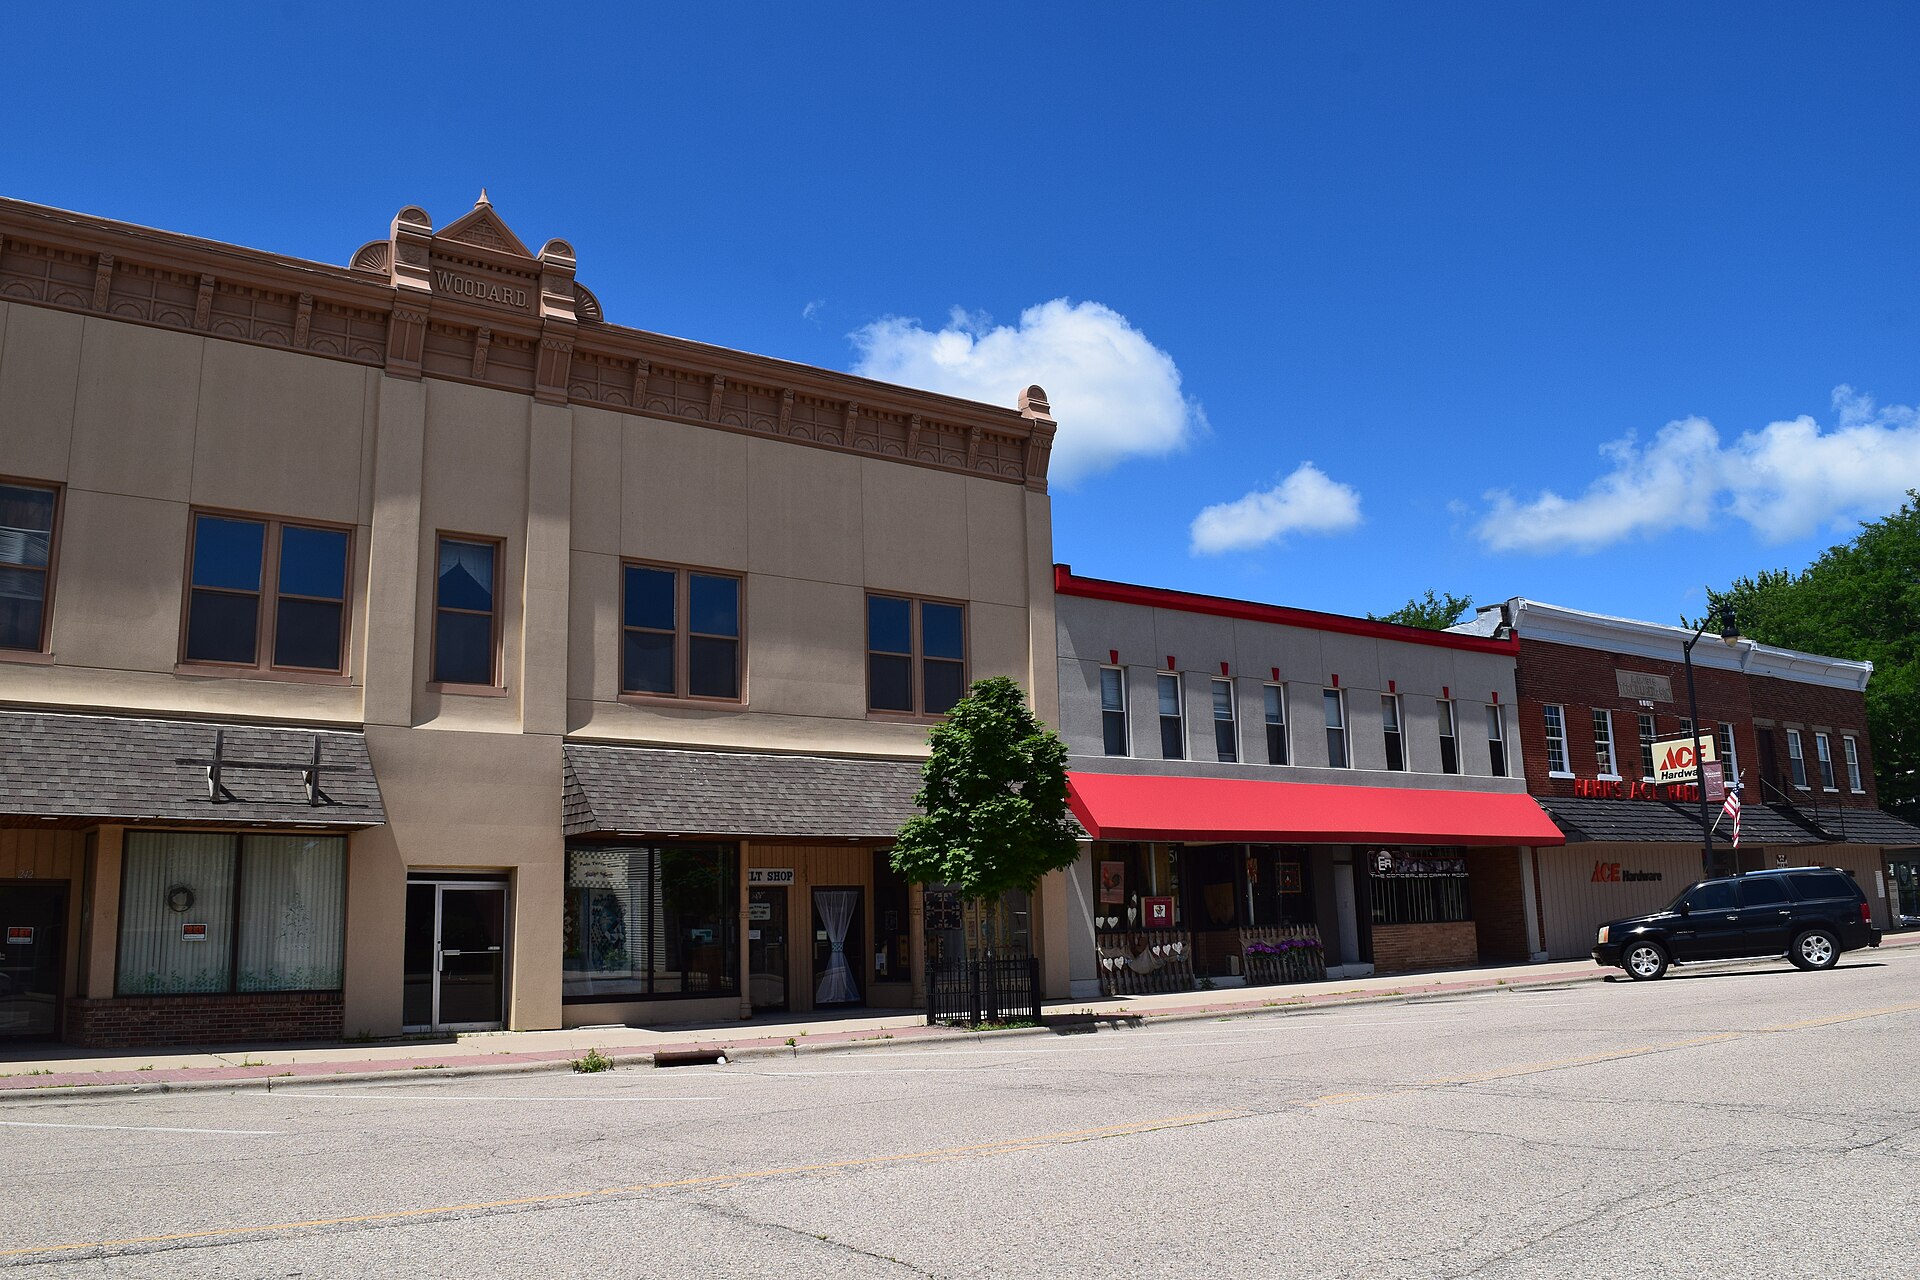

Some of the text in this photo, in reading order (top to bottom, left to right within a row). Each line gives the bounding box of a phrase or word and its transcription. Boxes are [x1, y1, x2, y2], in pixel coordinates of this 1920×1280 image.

[1660, 745, 1706, 770] ACE
[1661, 769, 1697, 780] Hardwa
[18, 869, 34, 879] 242
[767, 871, 793, 882] SHOP
[1591, 860, 1662, 882] ACE Hardware
